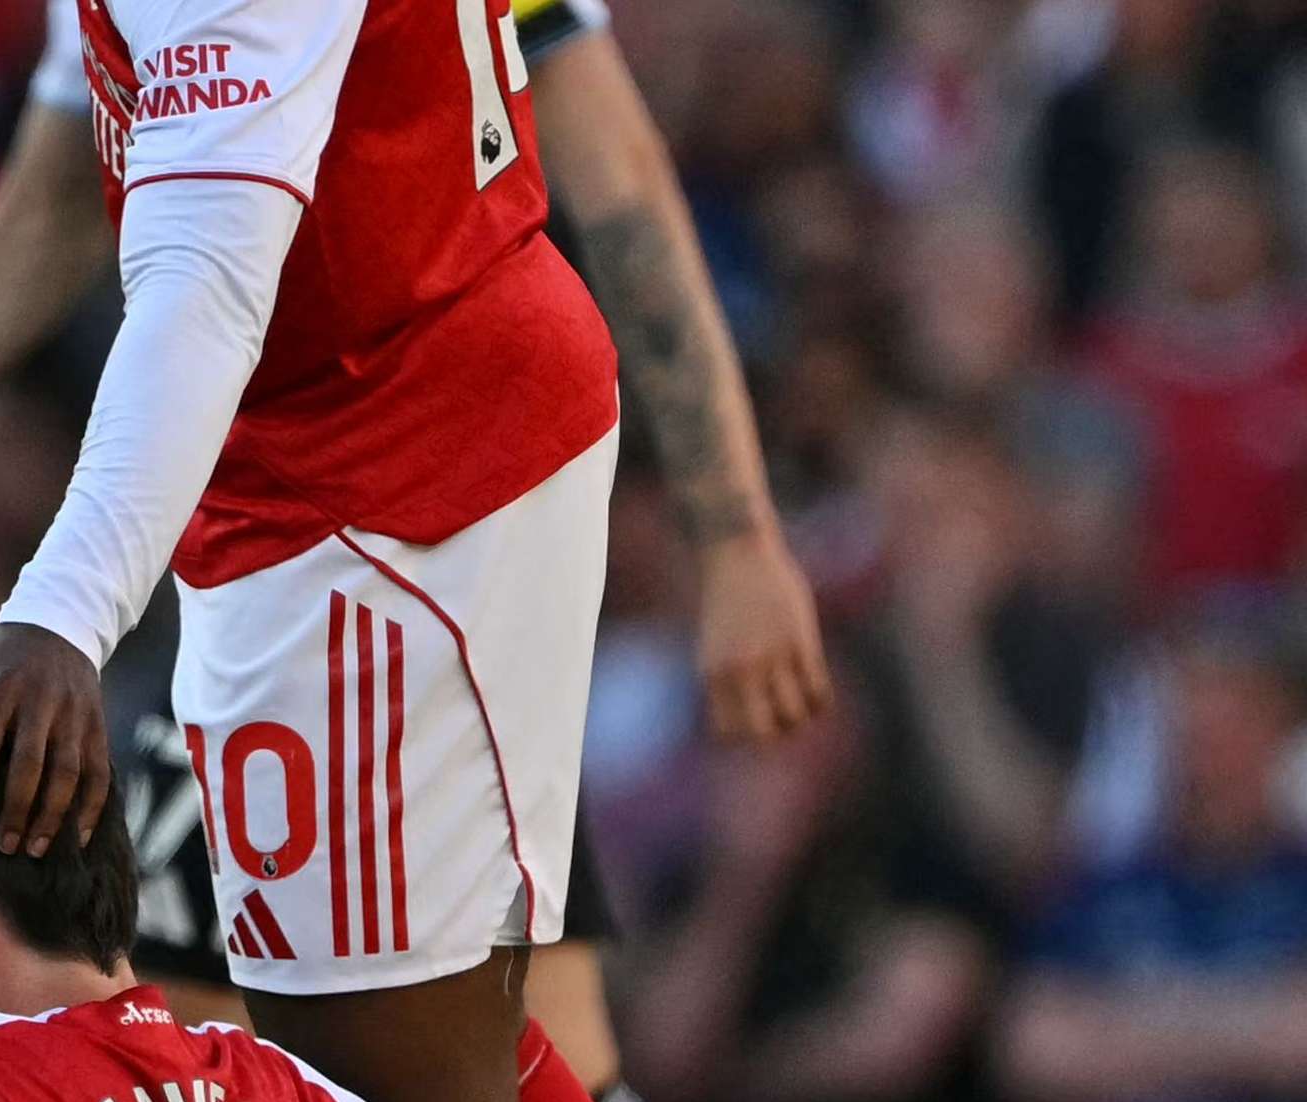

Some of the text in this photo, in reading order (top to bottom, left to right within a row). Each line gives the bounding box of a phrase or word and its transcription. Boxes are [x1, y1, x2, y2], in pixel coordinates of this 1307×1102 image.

[143, 43, 232, 79] VISIT
[135, 78, 273, 123] WANDA
[184, 720, 318, 882] 10
[119, 1001, 176, 1027] Arse
